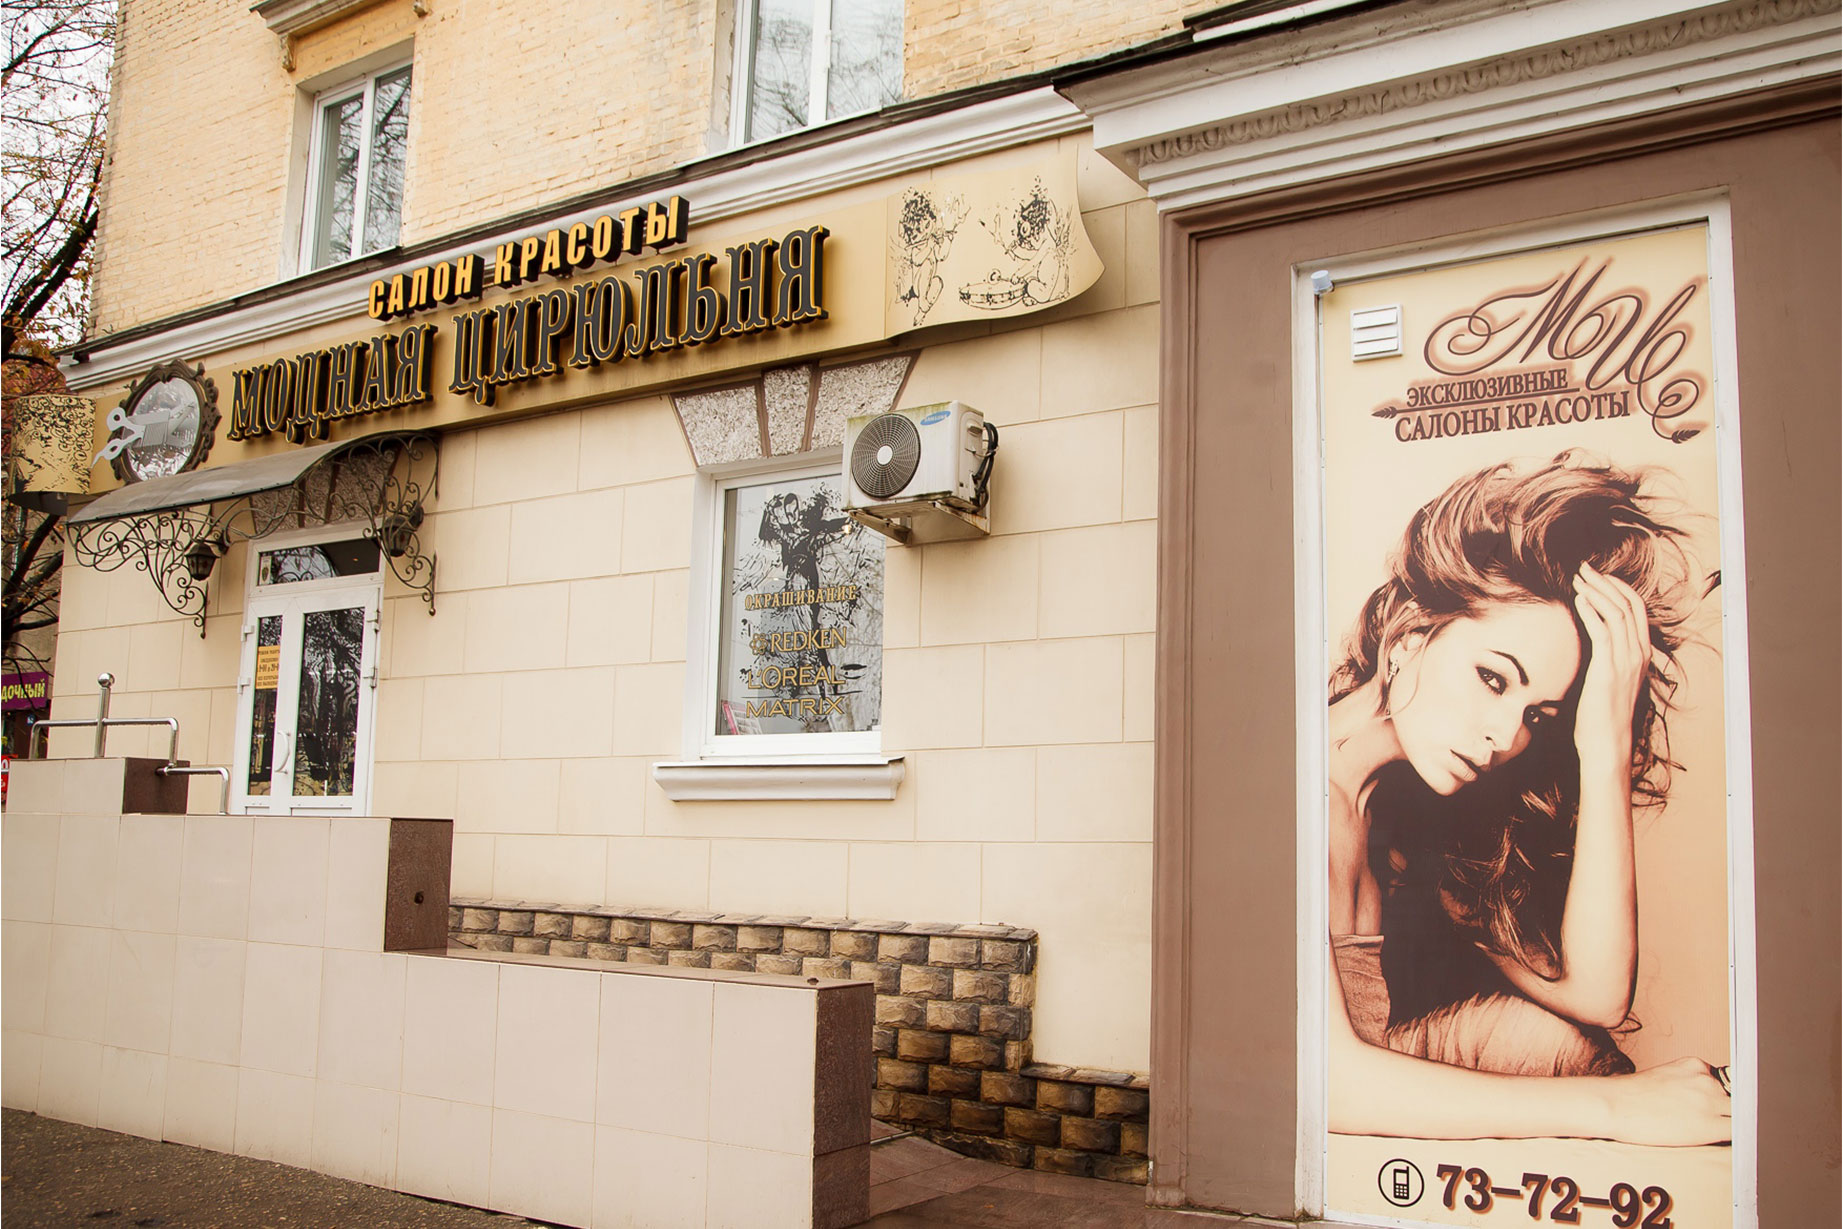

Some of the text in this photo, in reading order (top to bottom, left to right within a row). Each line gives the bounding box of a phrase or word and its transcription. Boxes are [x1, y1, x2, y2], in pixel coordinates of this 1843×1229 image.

[368, 196, 686, 320] САЛОН КРАСОТЫ
[226, 224, 829, 444] МОДНАЯ ЦИРЮЛЬНЯ
[1405, 367, 1568, 408] ЭКСКЛЮЗИВНЫЕ
[1394, 390, 1631, 443] САЛОНЫ КРАСОТЫ
[744, 585, 858, 611] ОКРАШИВАНИЕ
[770, 626, 847, 653] REDKEN
[745, 696, 845, 719] MATRIX
